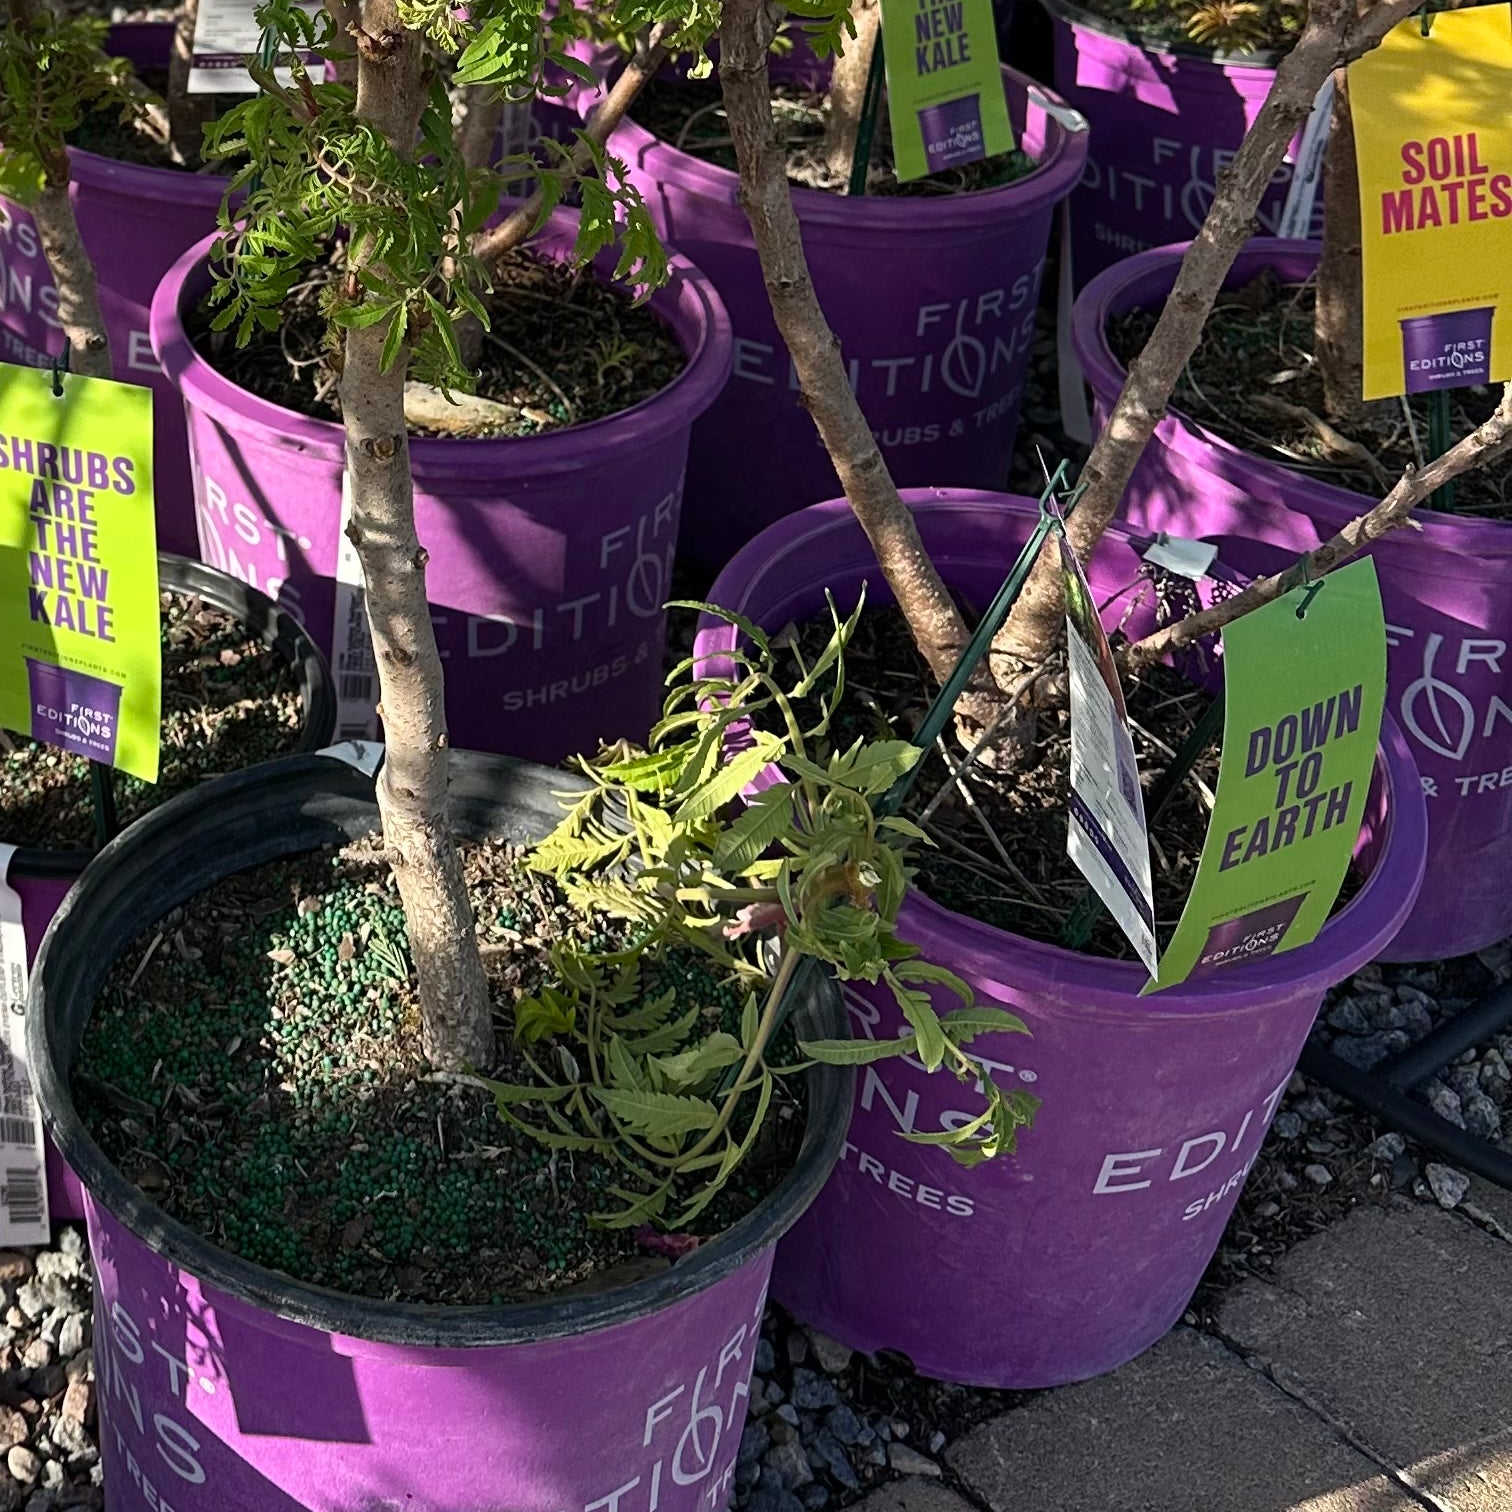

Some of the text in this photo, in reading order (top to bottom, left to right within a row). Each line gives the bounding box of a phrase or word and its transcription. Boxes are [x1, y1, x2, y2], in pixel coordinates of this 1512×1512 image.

[914, 1, 964, 45] NEW
[915, 32, 972, 77] KALE
[1400, 132, 1489, 185] SOIL
[1381, 174, 1512, 235] MATES
[734, 310, 1035, 397] EITIONS
[1409, 351, 1485, 370] EDITIONS
[1444, 339, 1485, 353] FIRST
[949, 418, 964, 437] &
[29, 478, 98, 527] ARE
[30, 515, 102, 565] THE
[29, 551, 109, 603] NEW
[28, 586, 116, 643] KALE
[503, 641, 649, 712] SHRUBS &
[36, 704, 112, 739] EDITIONS
[1244, 683, 1363, 778] DOWN
[1273, 751, 1323, 810] TO
[1218, 780, 1354, 873] EARTH
[1201, 933, 1280, 965] EDITIONS
[839, 1140, 975, 1217] TREES
